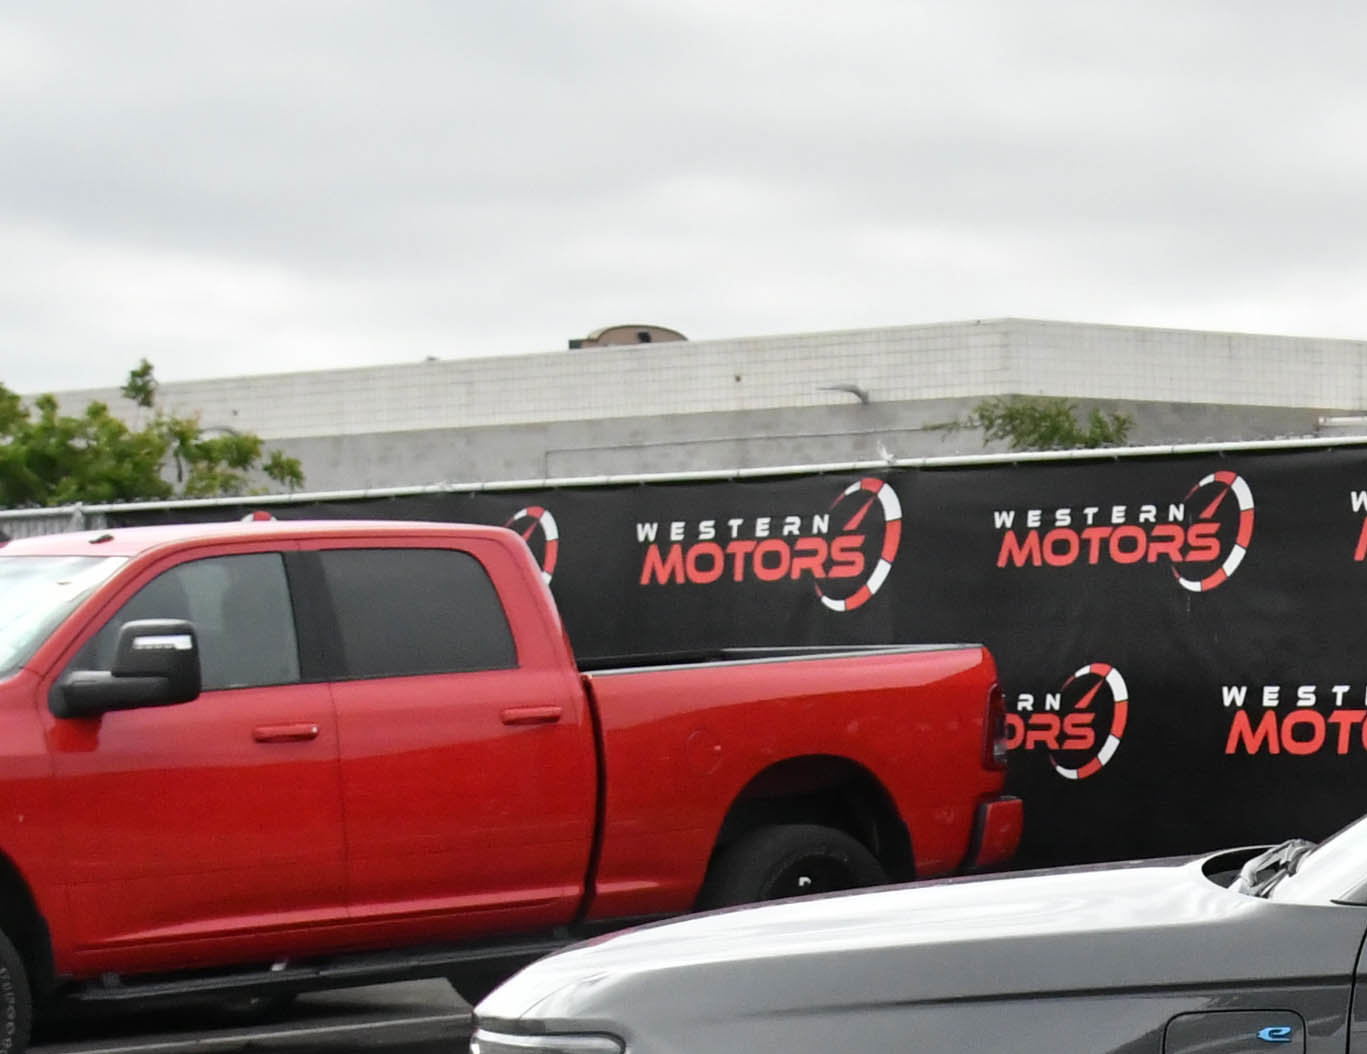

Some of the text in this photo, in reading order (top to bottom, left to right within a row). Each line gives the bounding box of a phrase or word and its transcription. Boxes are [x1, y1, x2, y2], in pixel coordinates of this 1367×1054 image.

[636, 513, 831, 543] WESTERN
[993, 503, 1186, 529] WESTERN
[639, 534, 866, 585] MOTORS
[996, 522, 1222, 568] MOTORS
